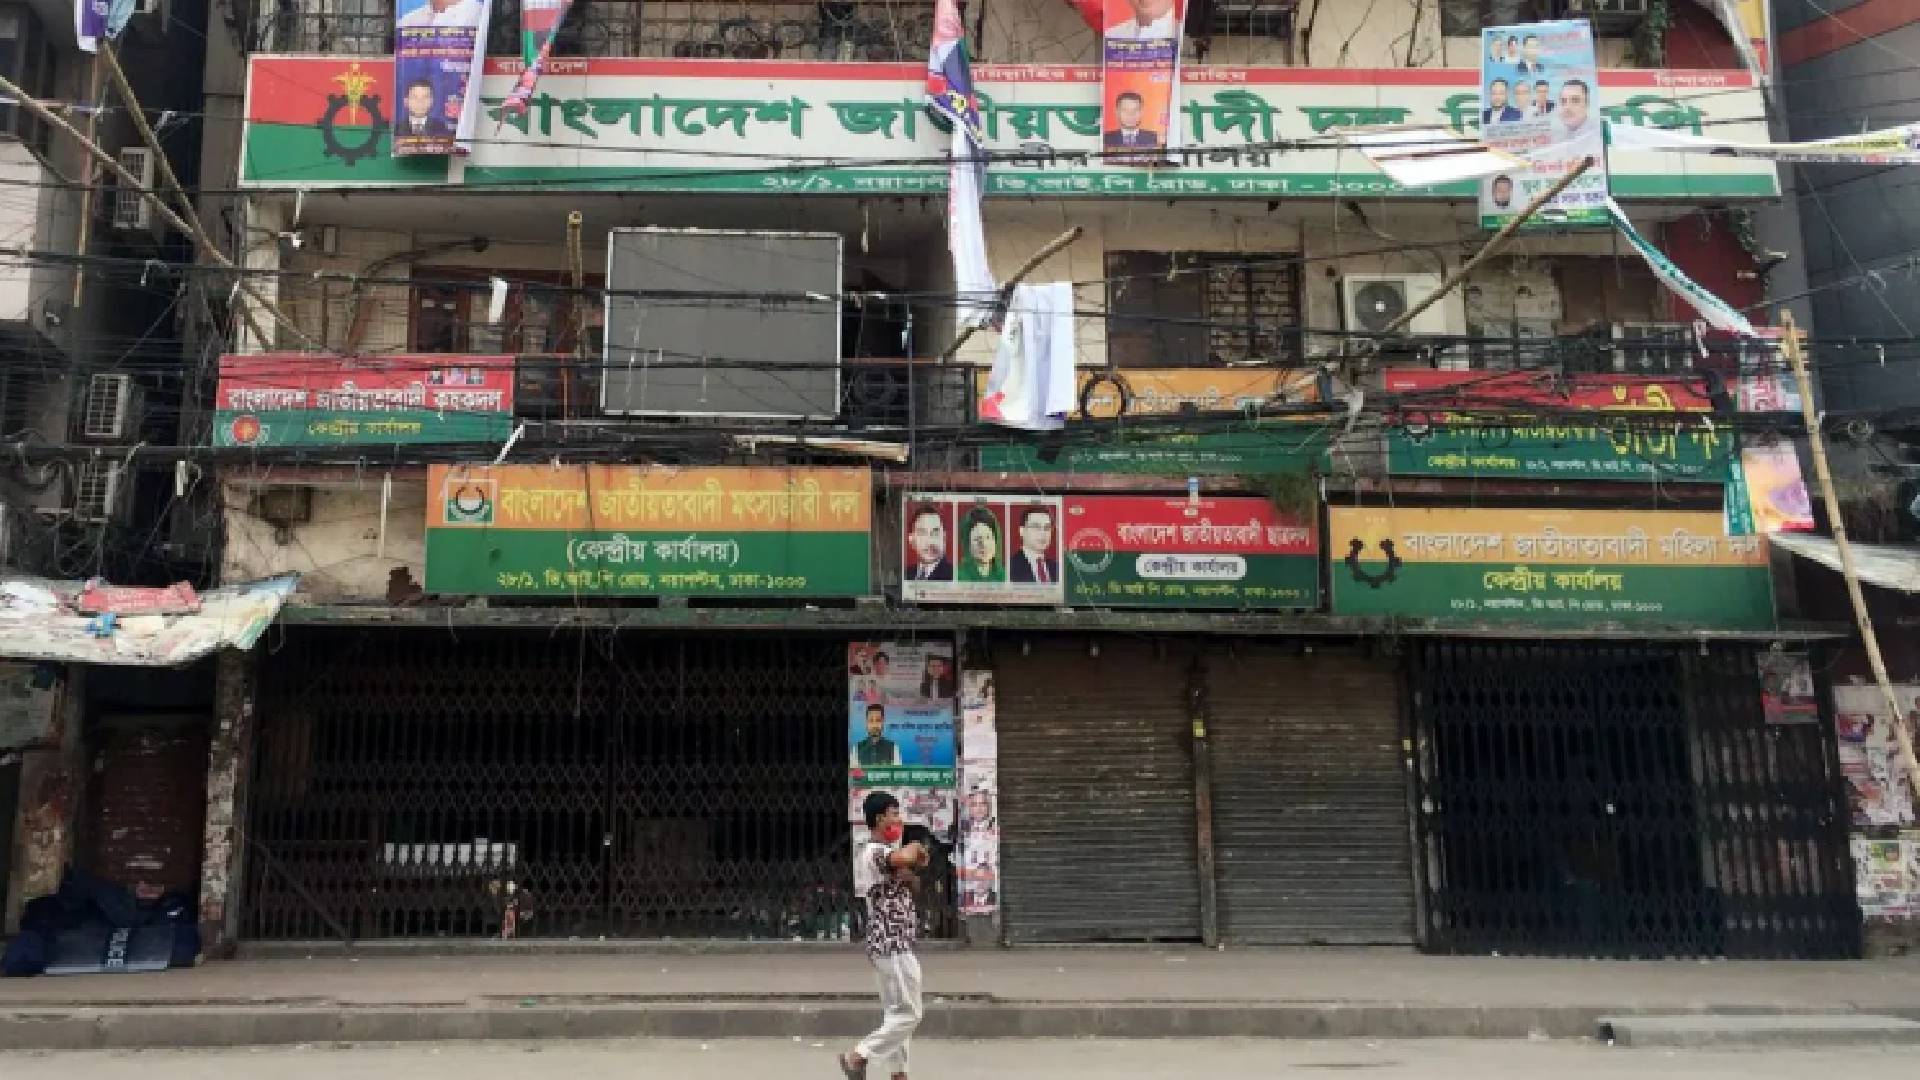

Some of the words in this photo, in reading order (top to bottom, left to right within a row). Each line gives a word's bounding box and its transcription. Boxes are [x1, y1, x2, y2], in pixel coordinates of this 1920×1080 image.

[481, 91, 813, 140] বাংলাদেশ
[827, 89, 1282, 143] জাীয়তাদী
[501, 485, 586, 522] বাংলাদেশ
[597, 477, 724, 523] জাতীয়তাবাদী
[828, 490, 862, 522] দল
[1402, 532, 1505, 560] বাংলাদেশ
[1512, 525, 1649, 562] জাতীয়তাবাদী
[1659, 528, 1718, 562] মহিলা
[1482, 565, 1547, 593] কেন্দ্রীয়
[1550, 566, 1624, 592] কার্যালয়
